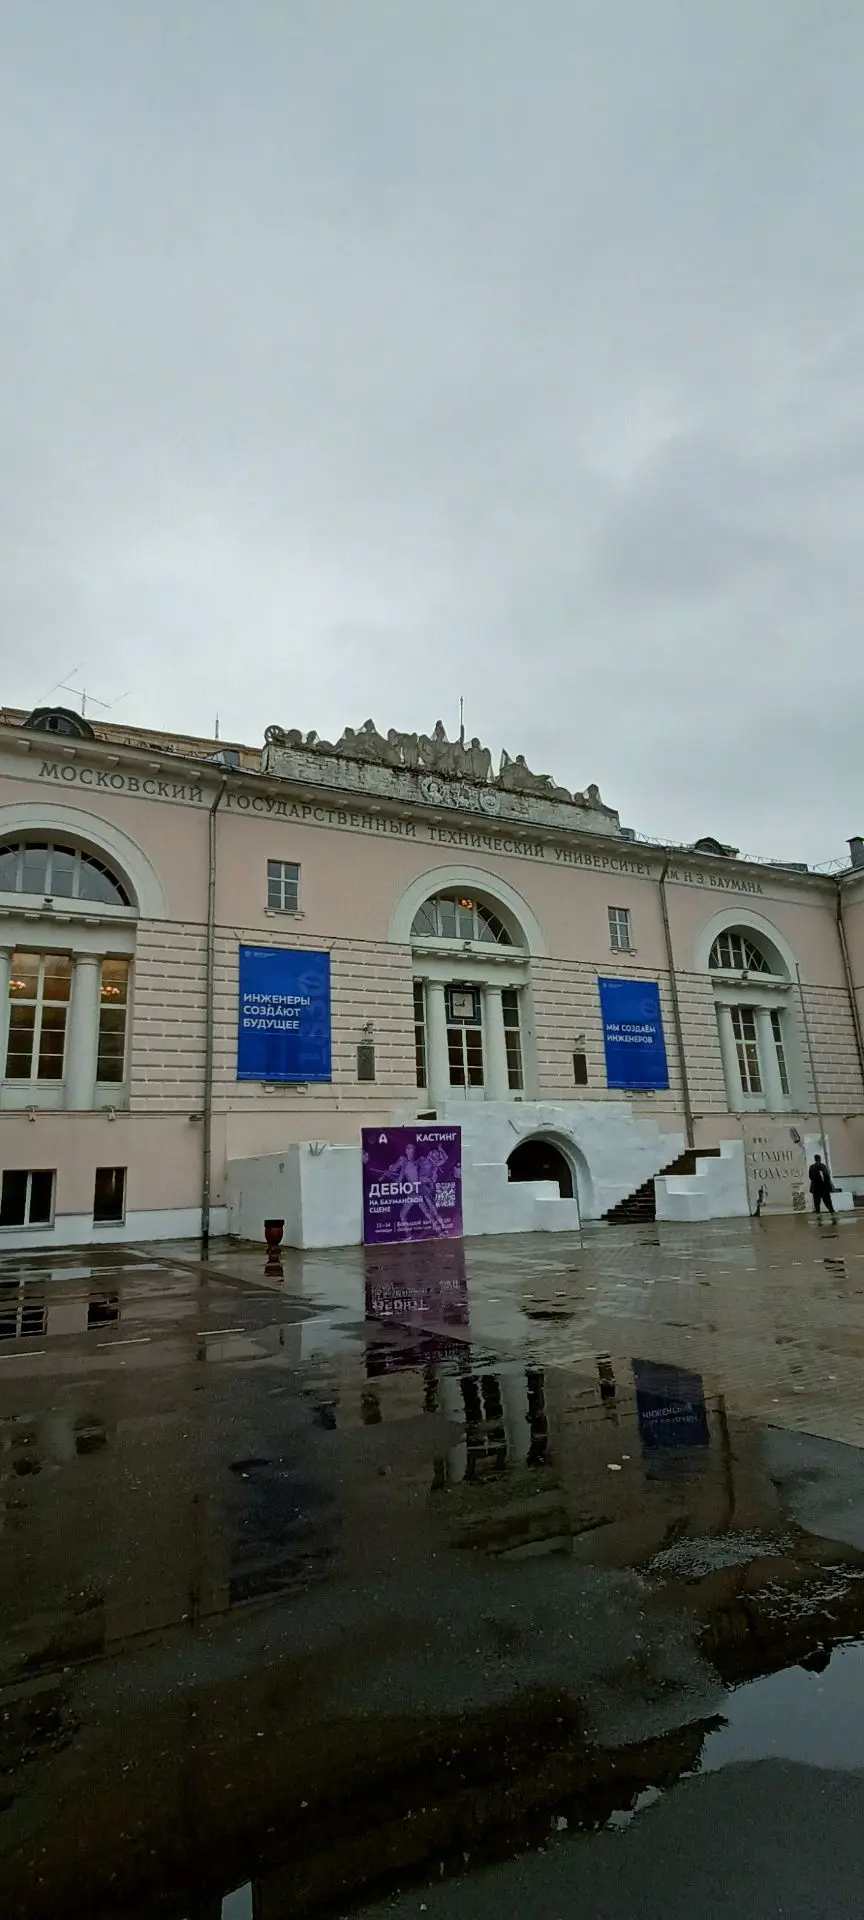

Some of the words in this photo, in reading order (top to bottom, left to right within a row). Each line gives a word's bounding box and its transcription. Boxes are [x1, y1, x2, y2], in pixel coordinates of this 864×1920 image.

[39, 762, 204, 803] МОСКОВСКИЙ
[225, 790, 417, 836] ГОСУДАРСТВЕННЫЙ
[427, 827, 545, 858] ТЕХНИЧЕСКИЙ
[553, 847, 652, 876] УНИВЕРСИТЕТ
[709, 875, 764, 894] БАУМАНА
[243, 993, 310, 1005] ИНЖЕНЕРЫ
[243, 1005, 301, 1017] СОЗДАЮТ
[243, 1018, 300, 1030] БУДУЩЕЕ
[606, 1023, 620, 1031] МЫ
[606, 1035, 653, 1043] ИНЖЕНЕРОВ
[416, 1132, 457, 1142] КАСТИНГ
[368, 1181, 422, 1198] ДЕБЮТ
[380, 1196, 424, 1205] БАУМАНСКОЙ
[369, 1206, 391, 1214] СЦЕНЕ
